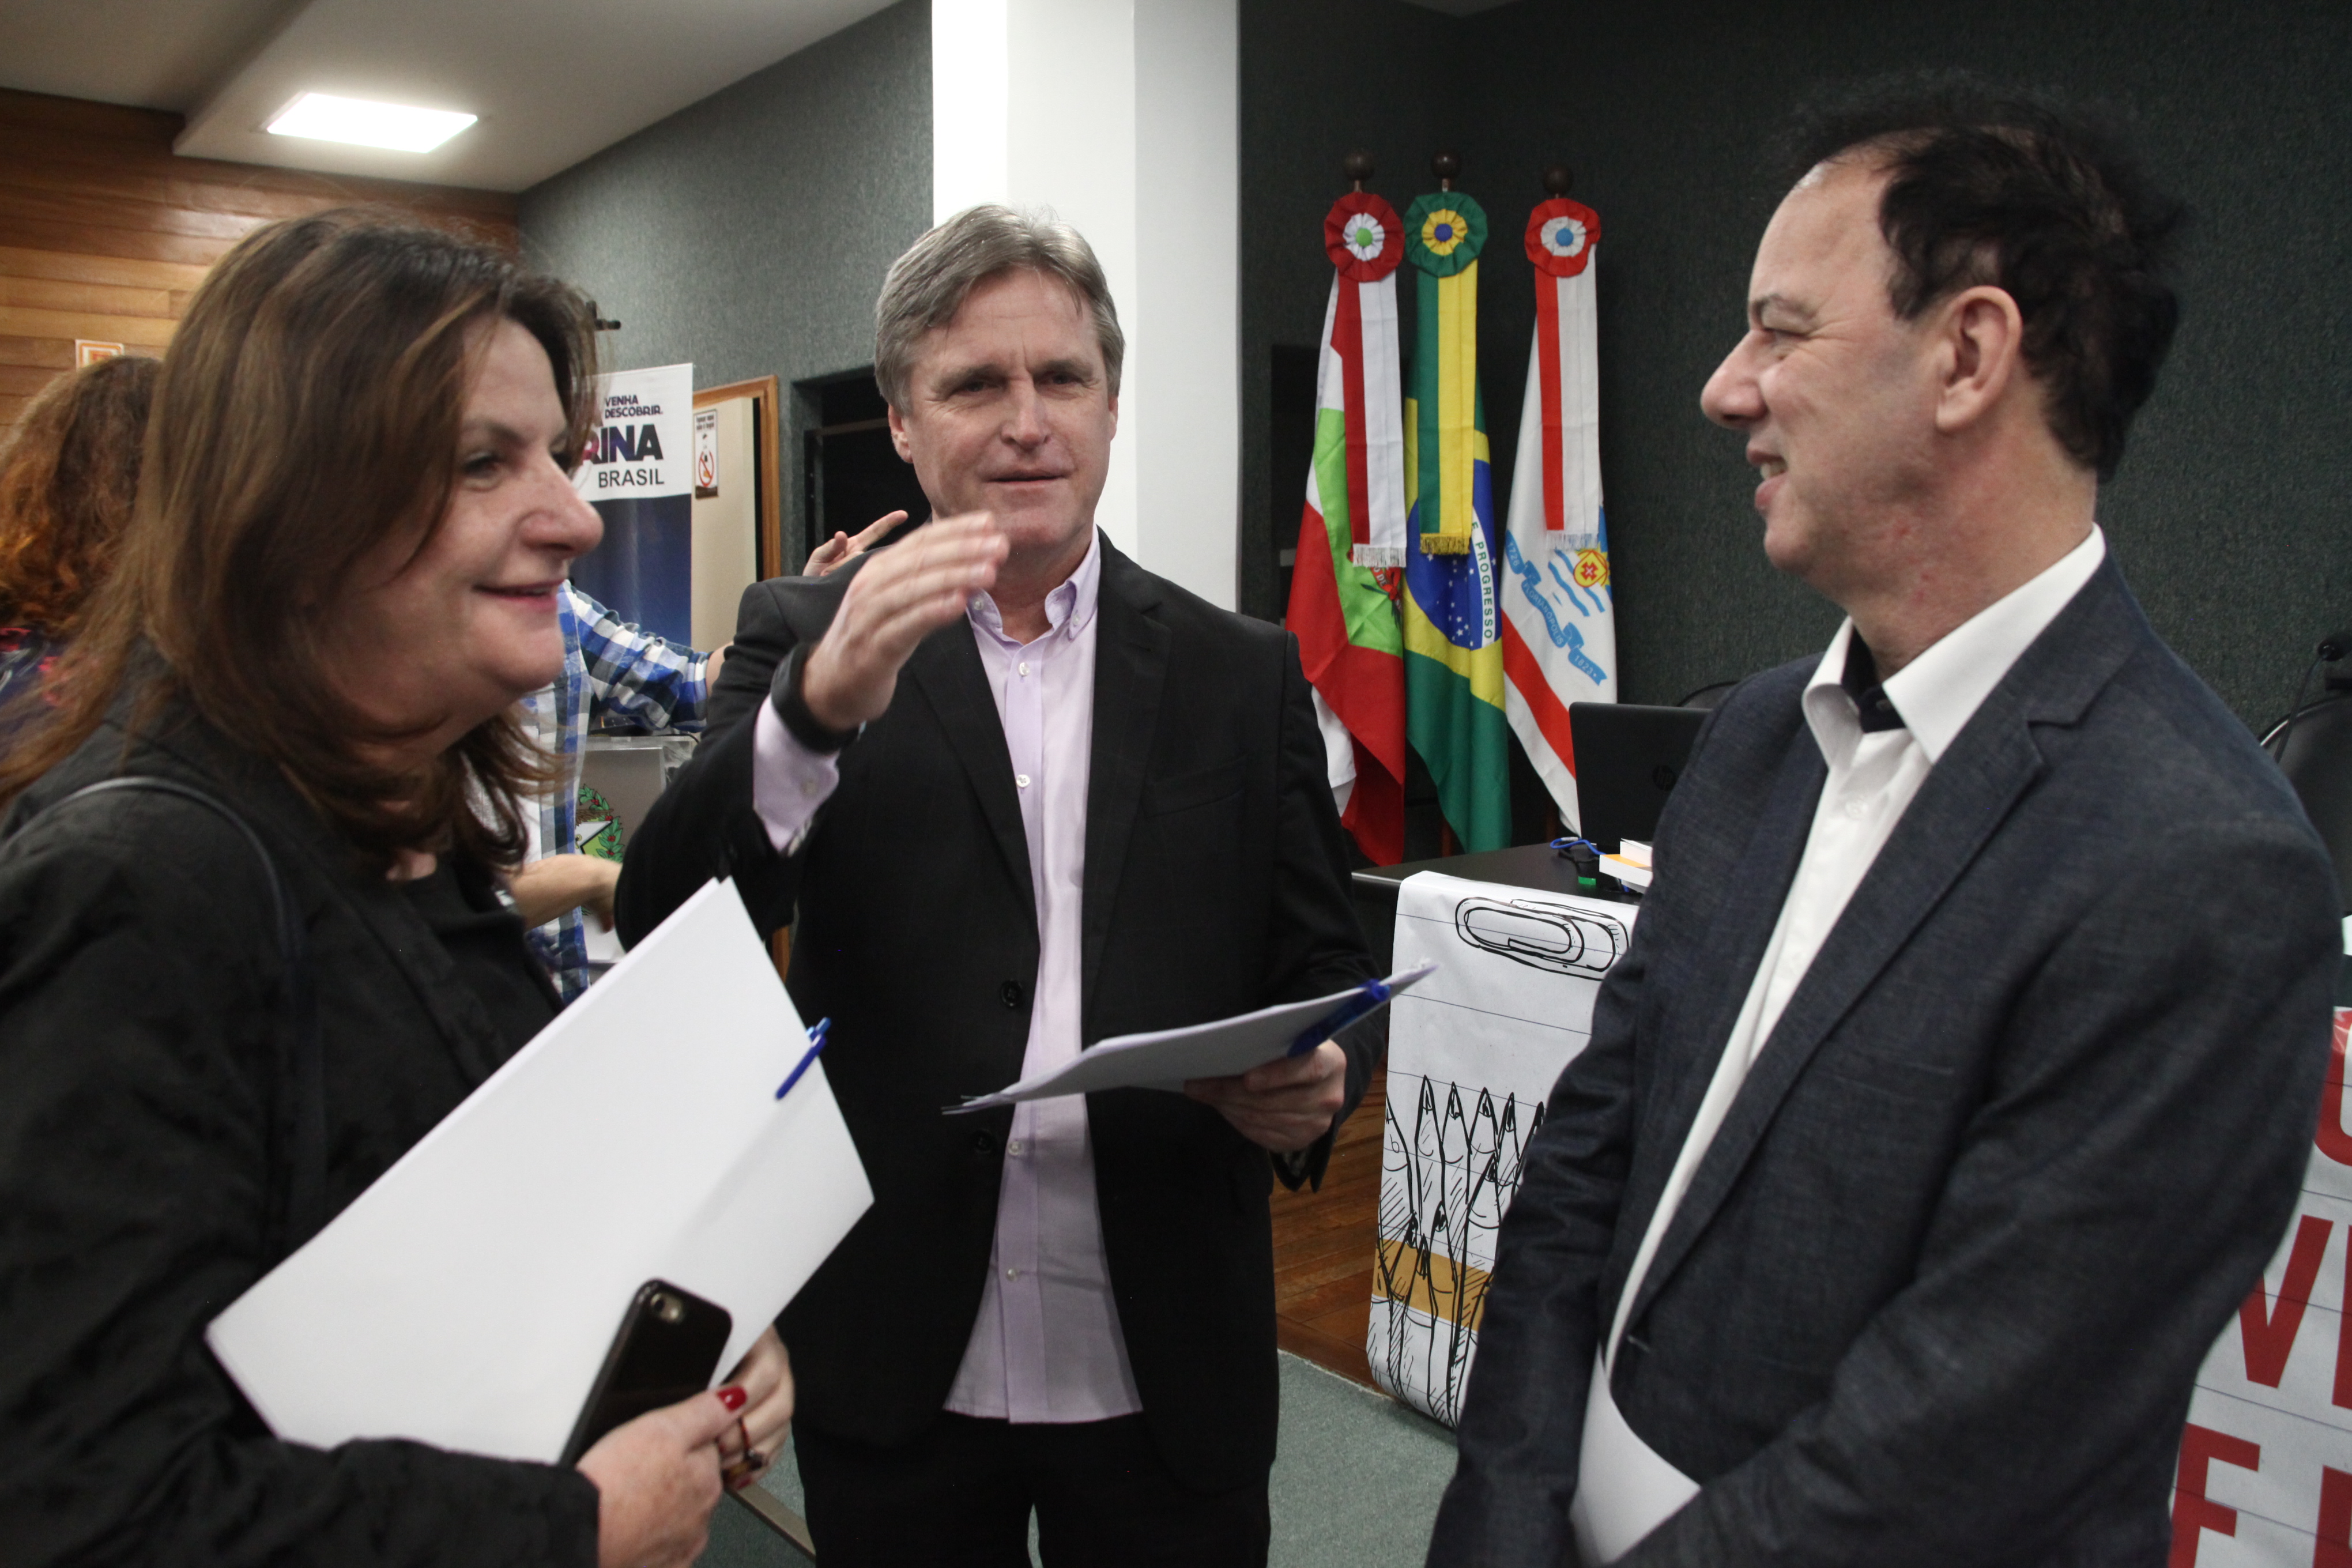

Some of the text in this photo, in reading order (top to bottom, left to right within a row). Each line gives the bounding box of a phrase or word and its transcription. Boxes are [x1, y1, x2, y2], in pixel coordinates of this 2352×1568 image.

[605, 394, 639, 407] VENHA
[598, 468, 665, 488] BRASIL
[1475, 541, 1493, 639] PROGRESSO
